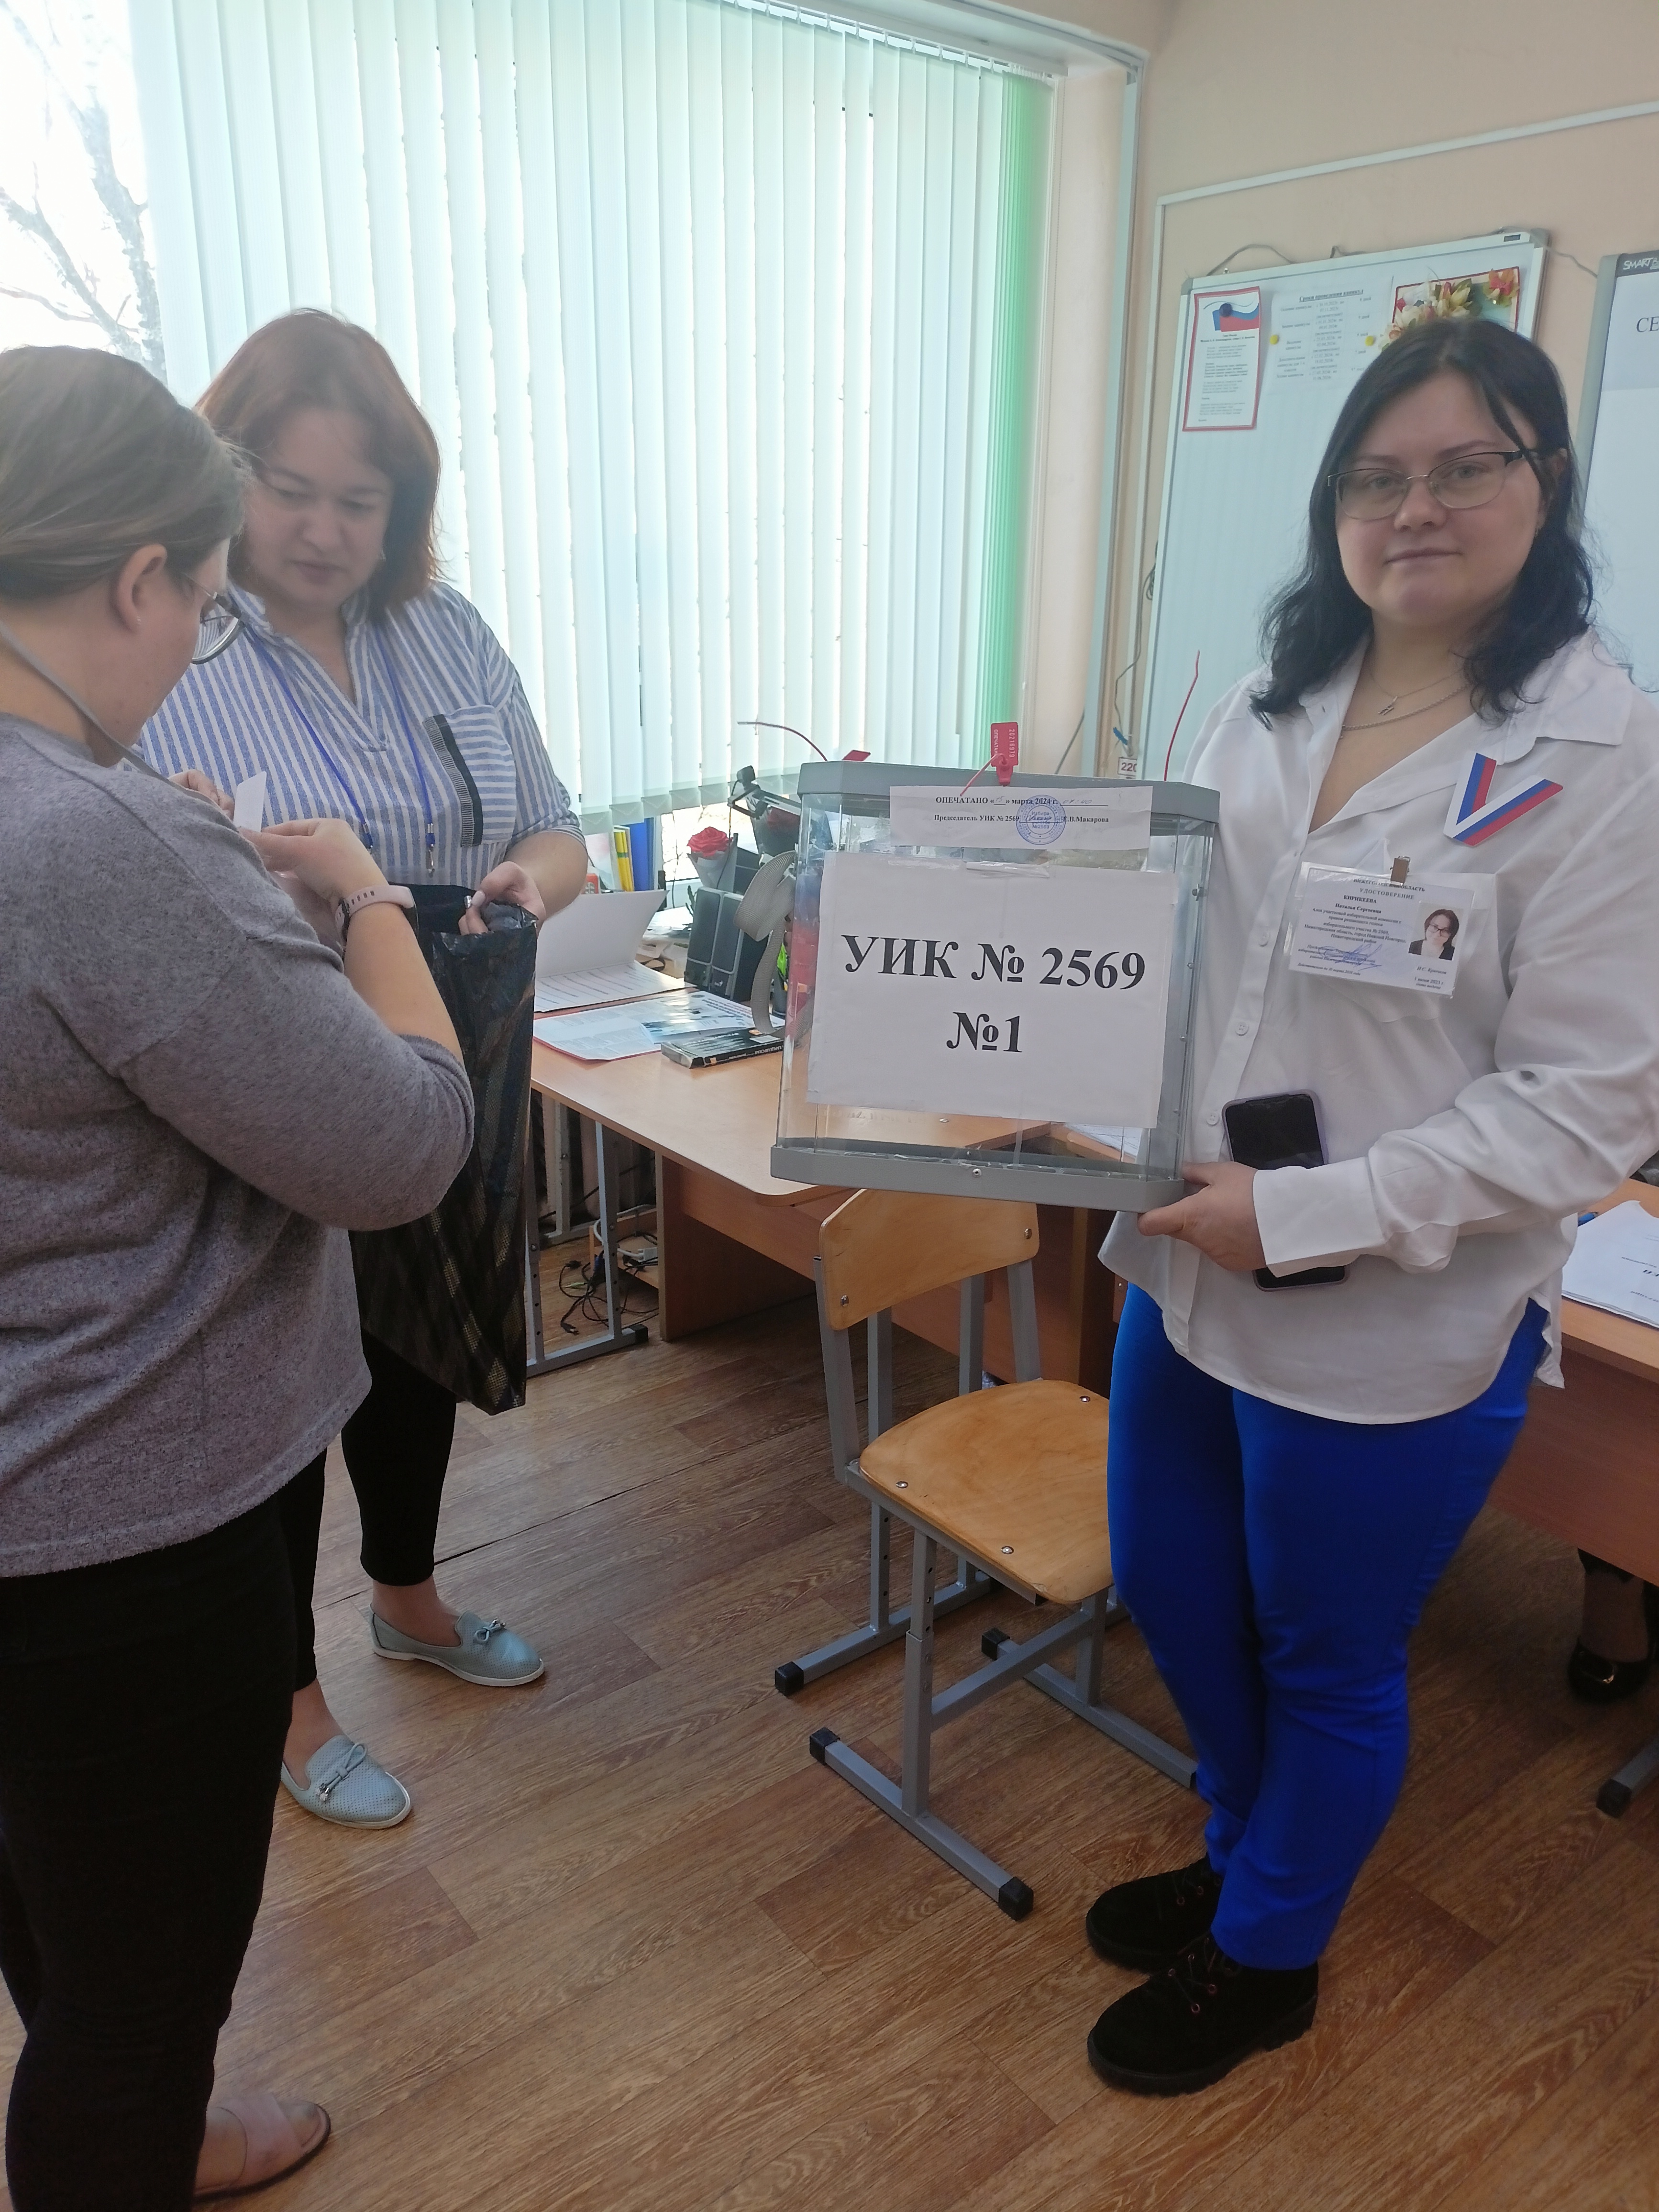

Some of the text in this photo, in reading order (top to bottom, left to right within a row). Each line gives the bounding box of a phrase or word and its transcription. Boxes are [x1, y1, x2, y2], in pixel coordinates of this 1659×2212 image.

[1623, 257, 1653, 270] SMART
[1343, 895, 1376, 903] КИРИКЕЕВА
[1360, 888, 1415, 899] УДОСТОВЕРЕНИЕ
[841, 935, 1146, 989] УИК № 2569
[946, 1012, 1023, 1053] №1
